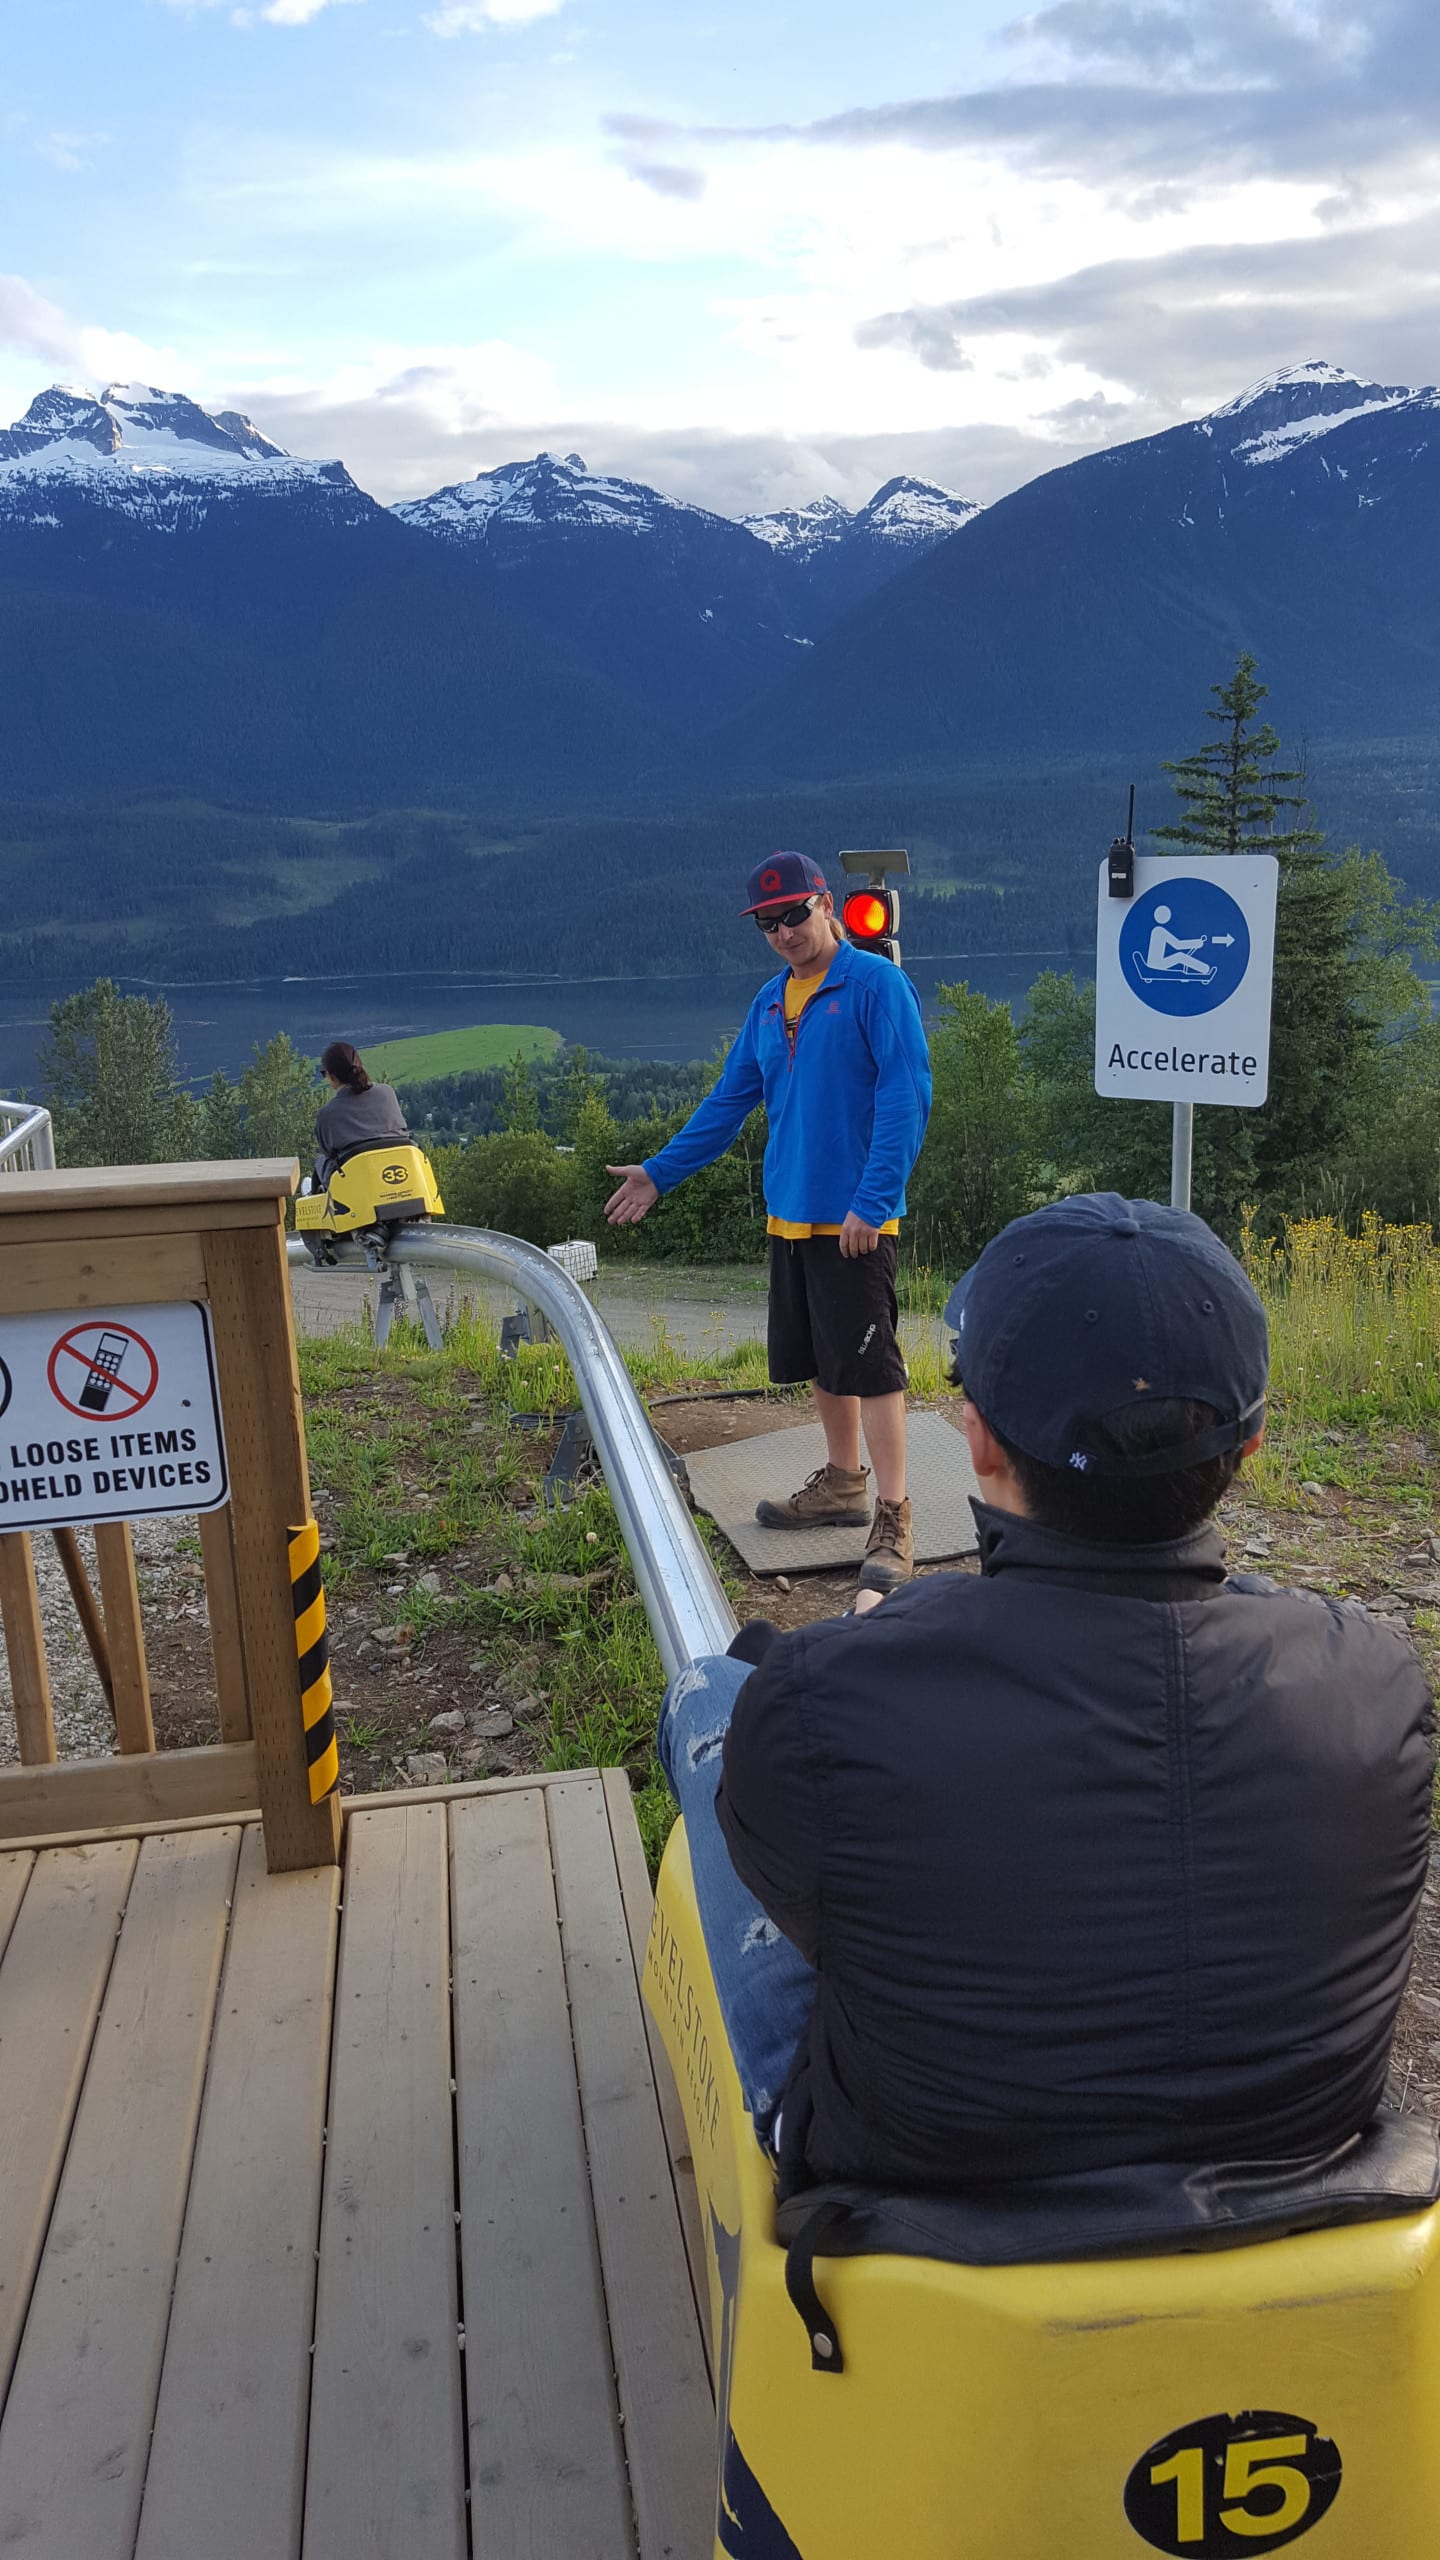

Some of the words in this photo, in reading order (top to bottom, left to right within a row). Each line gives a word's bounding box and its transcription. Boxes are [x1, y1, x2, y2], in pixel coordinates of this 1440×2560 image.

[1109, 1043, 1257, 1076] Accelerate
[384, 1168, 407, 1181] 33
[10, 1437, 101, 1469] LOOSE
[110, 1428, 197, 1459] ITEMS
[93, 1460, 211, 1494] DEVICES
[648, 1946, 684, 2052] MOUNTAIN
[1151, 2434, 1310, 2543] 15
